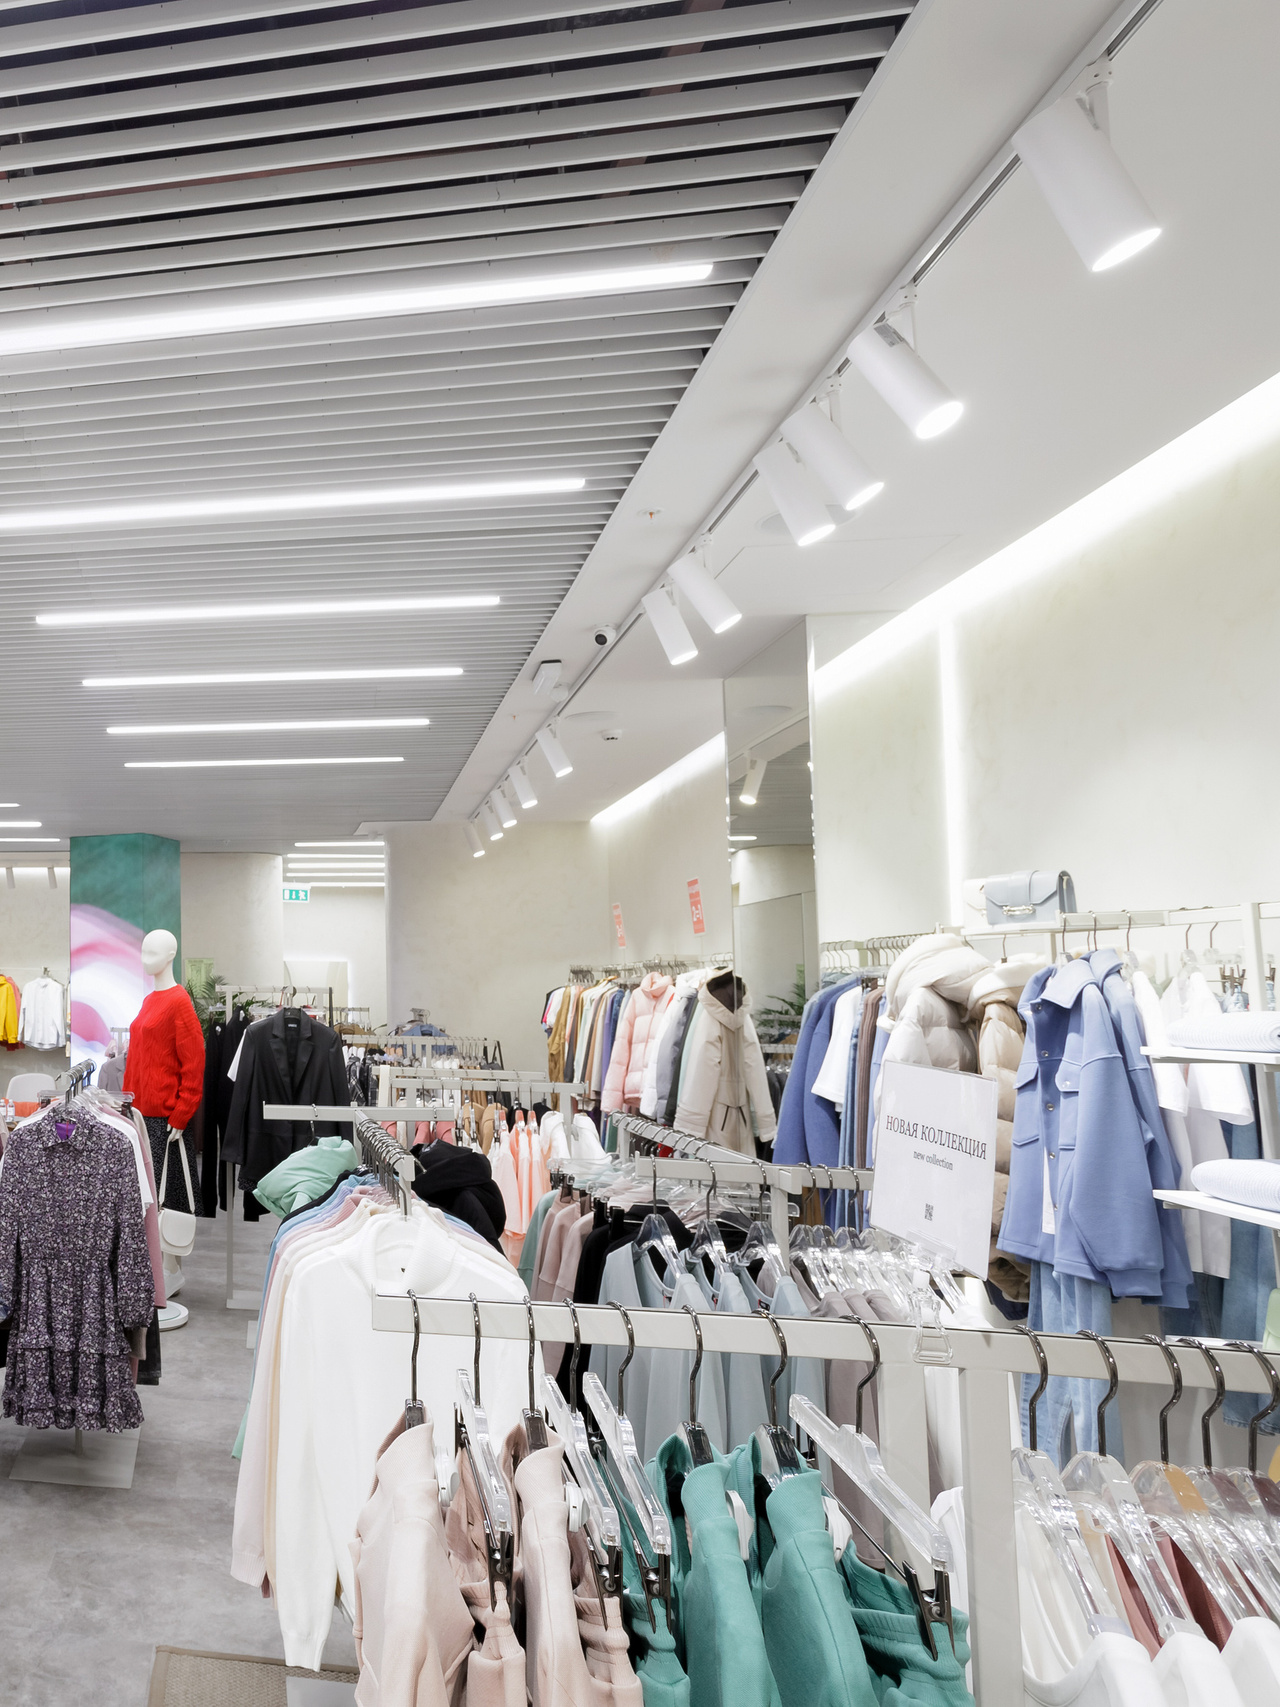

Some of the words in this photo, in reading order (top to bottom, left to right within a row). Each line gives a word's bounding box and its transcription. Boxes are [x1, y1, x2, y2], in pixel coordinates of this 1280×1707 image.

[886, 1115, 918, 1138] НОВАЯ
[920, 1124, 987, 1160] КОЛЛЕКЦИЯ
[913, 1150, 925, 1161] new
[925, 1153, 954, 1171] collection
